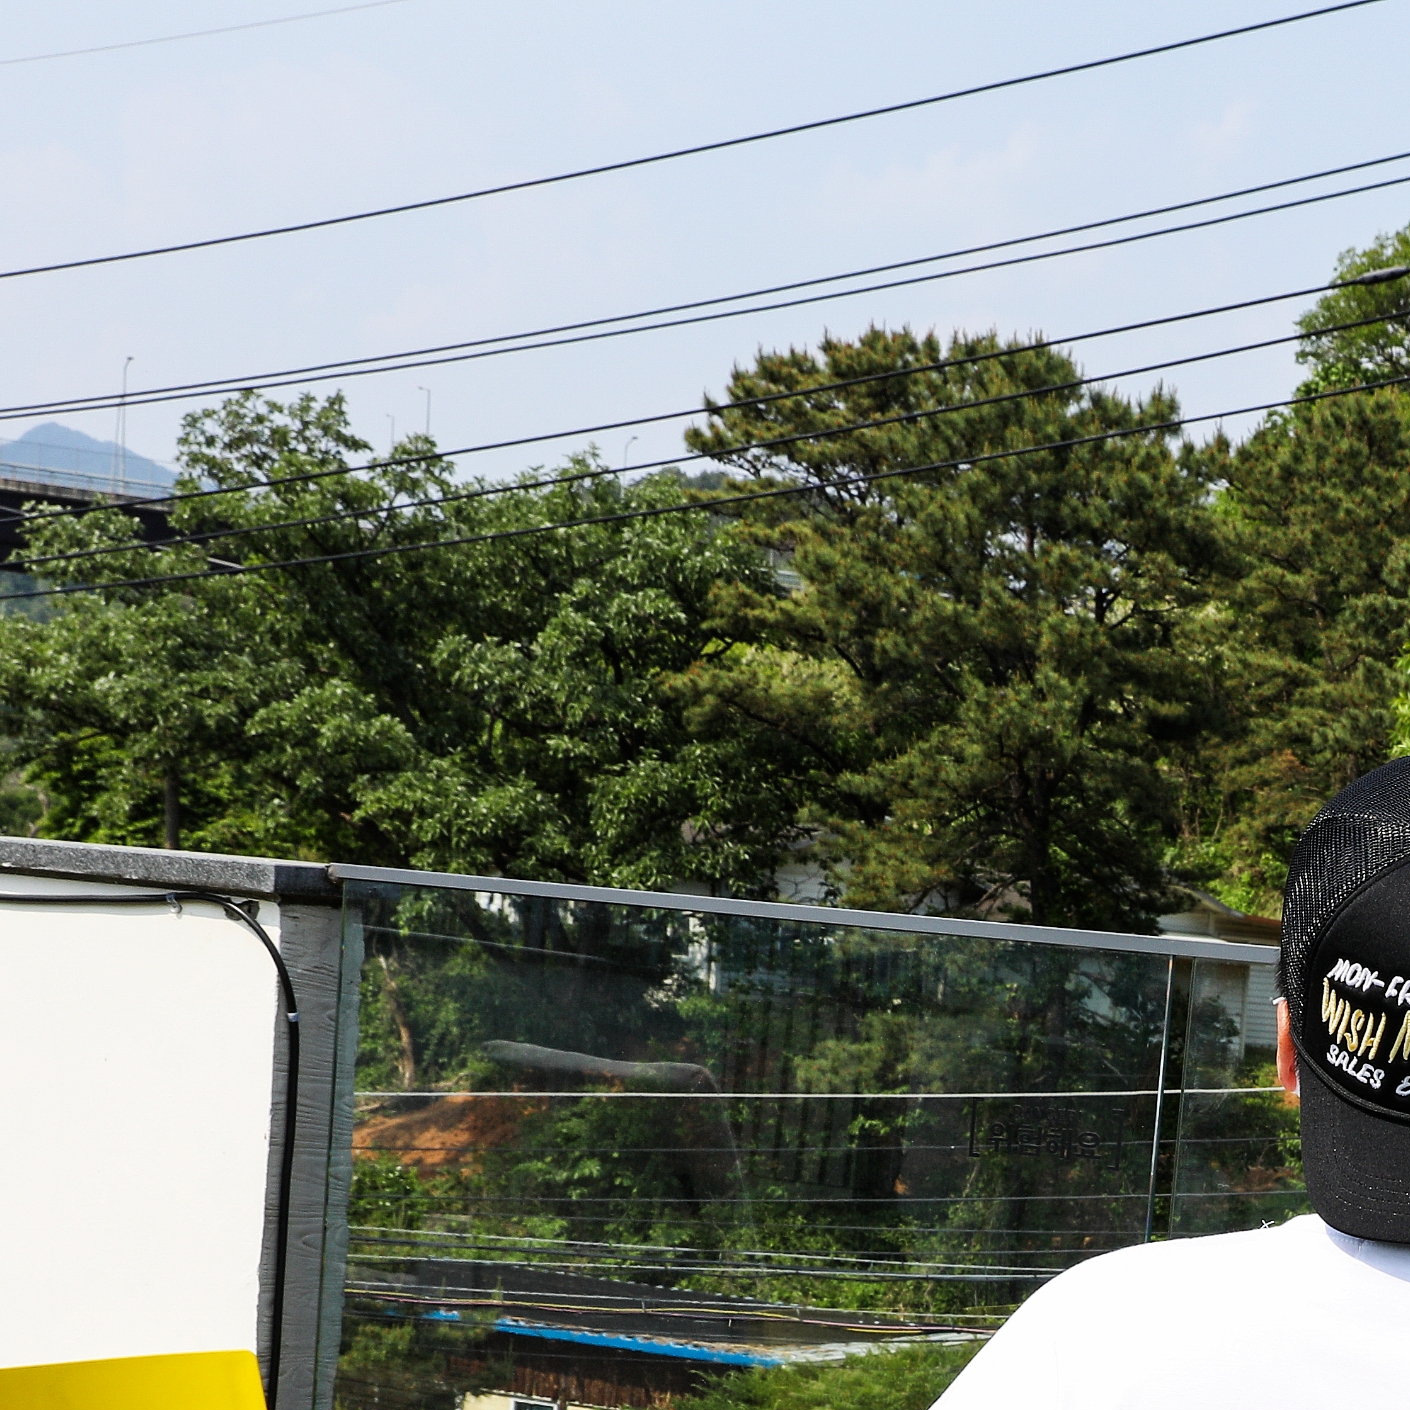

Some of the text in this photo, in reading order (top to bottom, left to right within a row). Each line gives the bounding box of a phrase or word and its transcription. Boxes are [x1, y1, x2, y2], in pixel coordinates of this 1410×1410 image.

[1322, 977, 1387, 1061] WISH
[1327, 1044, 1386, 1089] SALES
[988, 1121, 1102, 1159] 위험해요
